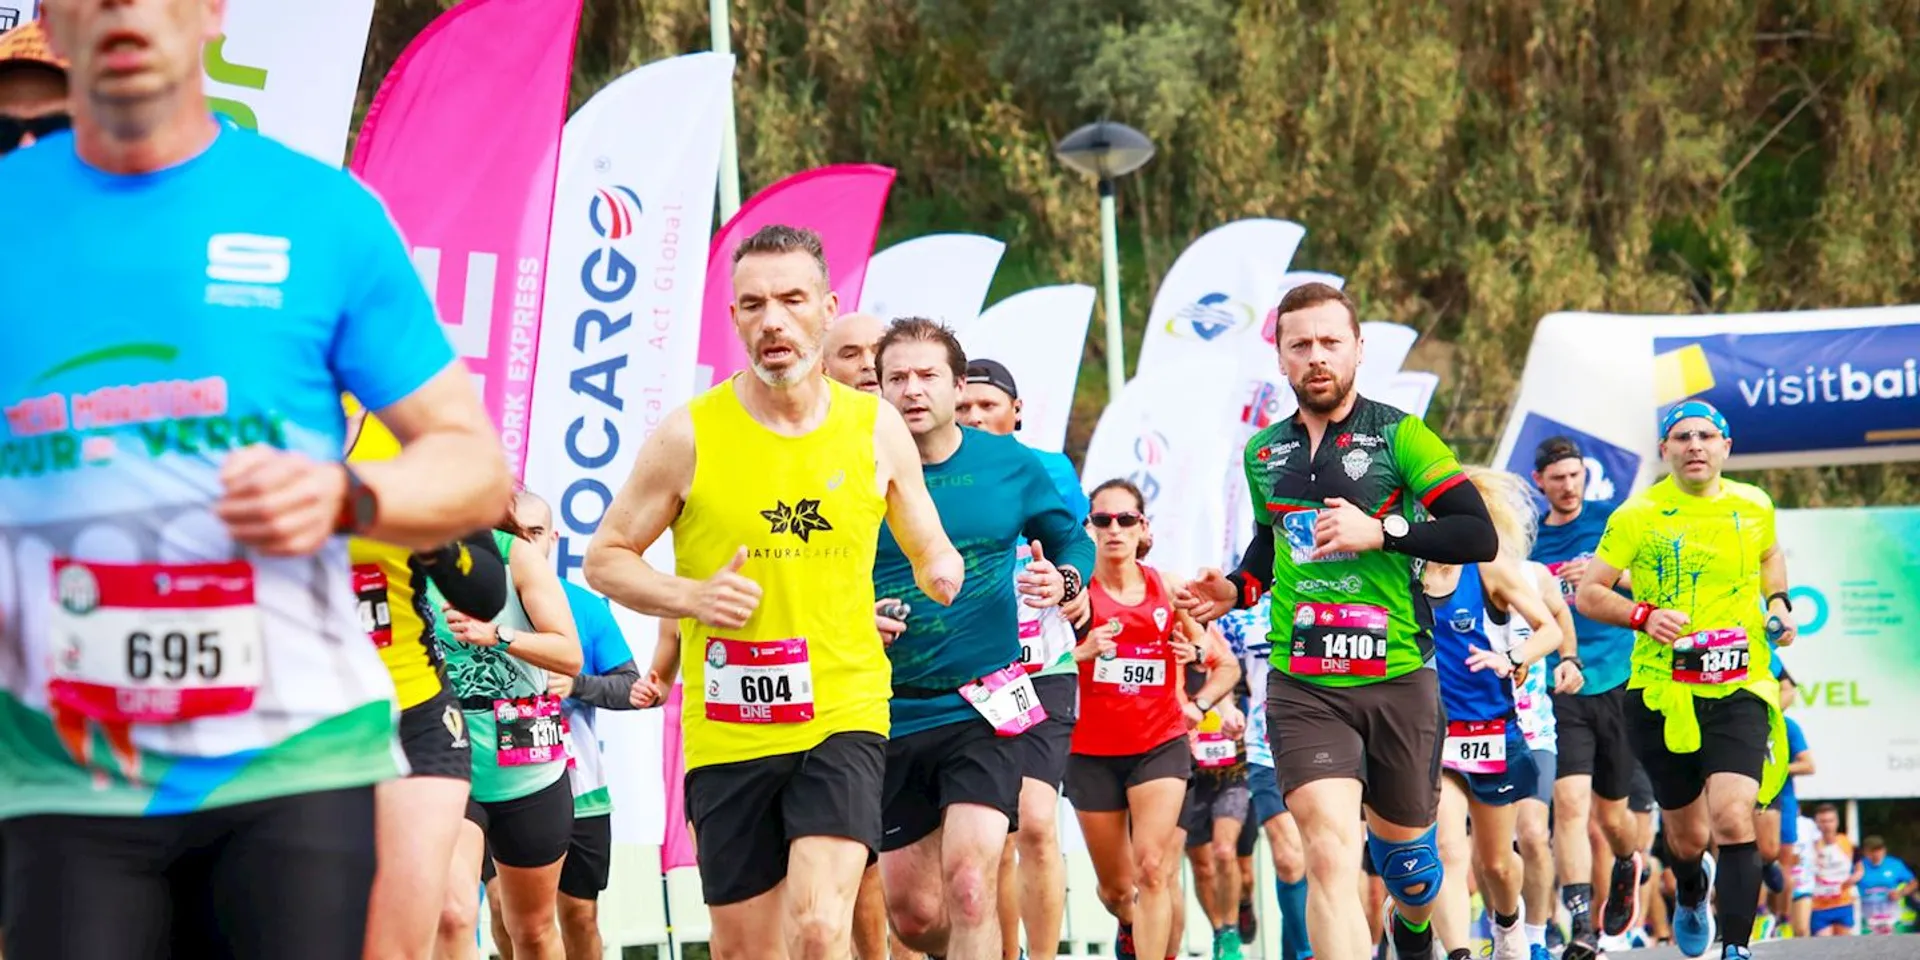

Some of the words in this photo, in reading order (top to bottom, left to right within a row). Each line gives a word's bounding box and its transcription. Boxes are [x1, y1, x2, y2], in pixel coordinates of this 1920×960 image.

[507, 257, 540, 382] EXPRESS
[557, 184, 643, 578] TOCARGO
[1738, 358, 1920, 407] visitbai
[926, 474, 974, 488] ETUS
[126, 630, 222, 681] 695
[1322, 634, 1373, 660] 1410
[1322, 659, 1350, 670] ONE
[1700, 649, 1740, 672] 1347
[1123, 665, 1154, 683] 594
[741, 675, 793, 704] 604
[1796, 681, 1870, 707] VEL
[740, 705, 772, 719] ONE
[1460, 742, 1490, 760] 874
